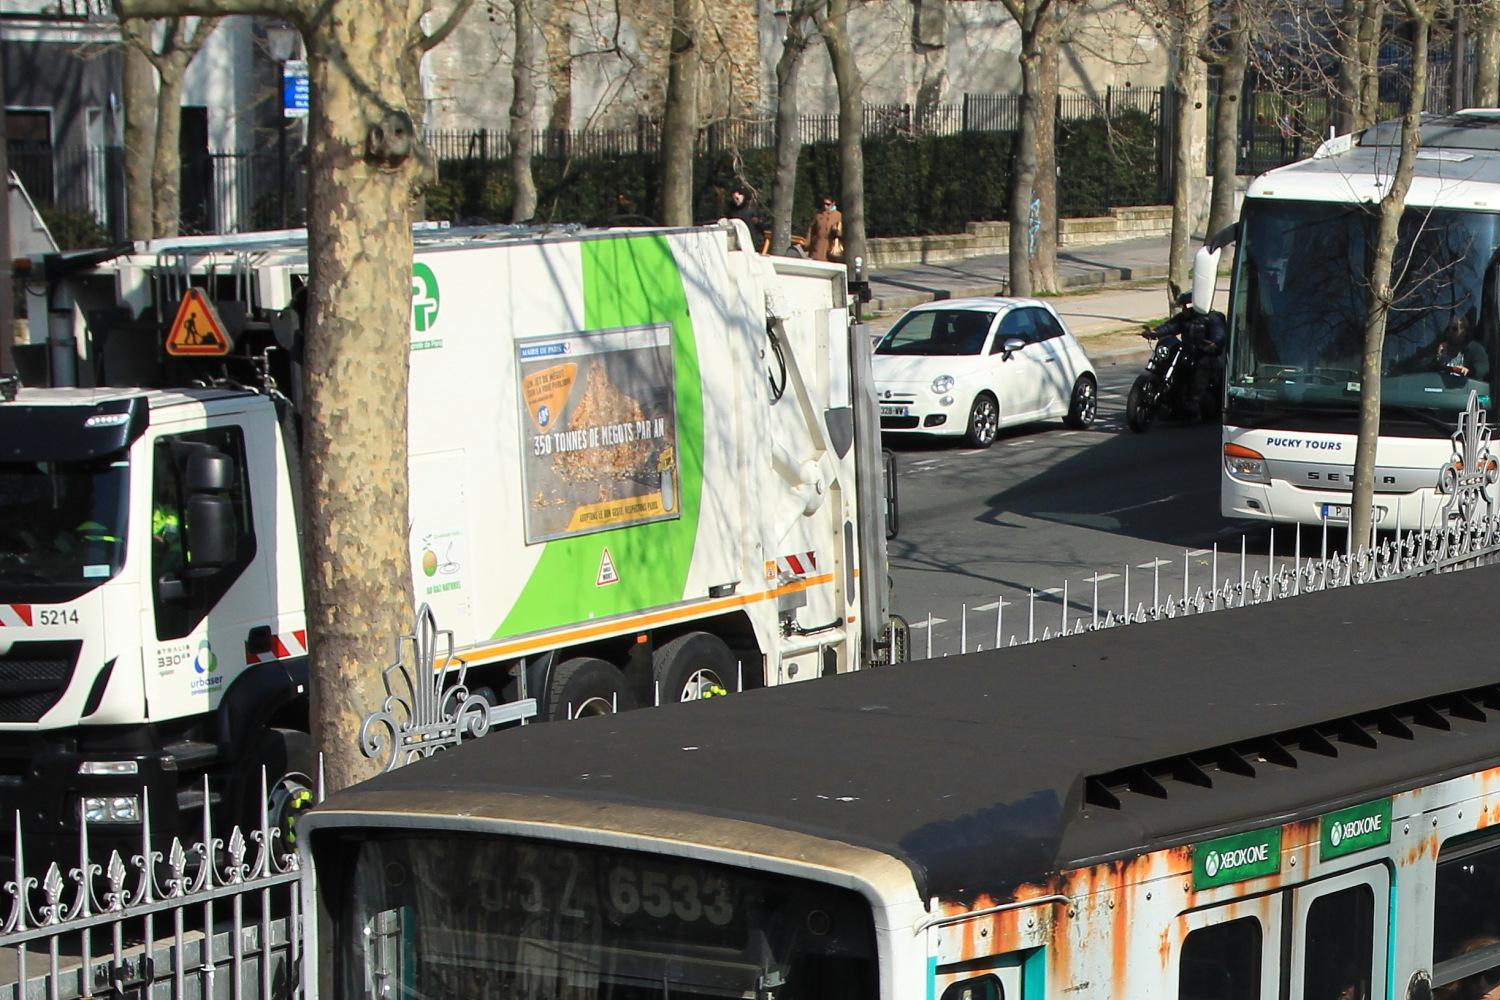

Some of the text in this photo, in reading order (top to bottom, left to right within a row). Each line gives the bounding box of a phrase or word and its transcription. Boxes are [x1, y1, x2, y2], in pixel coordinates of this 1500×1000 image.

[534, 434, 551, 455] 350
[554, 430, 587, 452] TONNES
[590, 427, 599, 447] DE
[636, 421, 652, 440] PAR
[654, 418, 664, 438] AN
[1266, 437, 1342, 451] PUCKY TOURS
[40, 609, 79, 625] 5214
[158, 655, 181, 668] 330
[191, 676, 223, 688] urbaser
[609, 866, 733, 926] 6533
